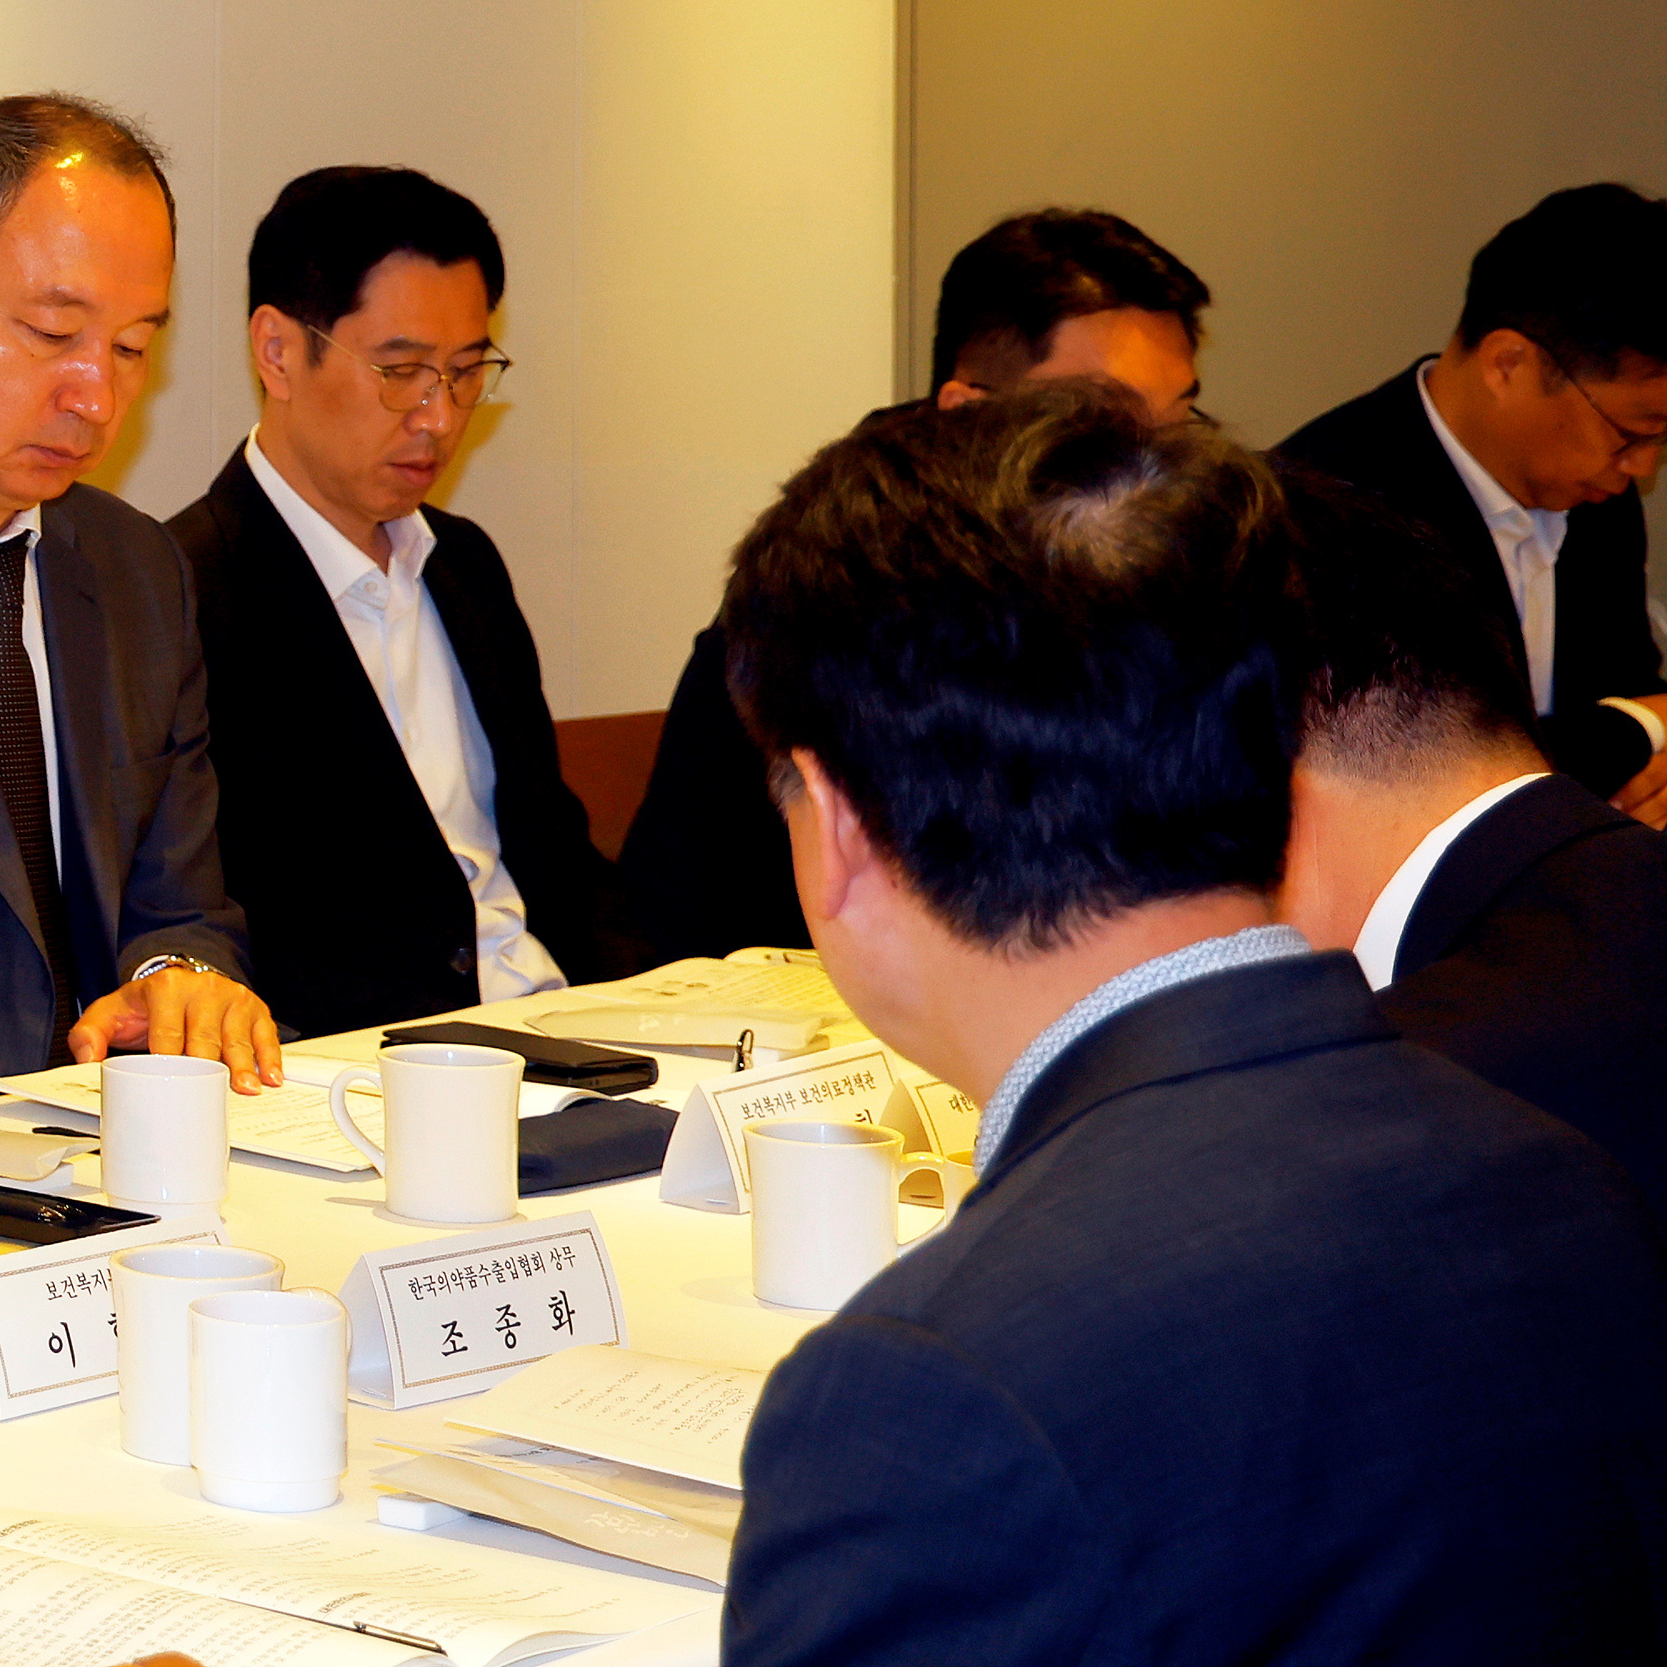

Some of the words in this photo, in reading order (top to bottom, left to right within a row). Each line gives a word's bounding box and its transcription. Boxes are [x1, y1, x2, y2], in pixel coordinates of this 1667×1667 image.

[740, 1090, 796, 1120] 보건복지부
[407, 1251, 546, 1301] 한국의약품수출입협회
[549, 1246, 576, 1272] 상무
[440, 1320, 469, 1357] 조
[494, 1303, 522, 1350] 종
[548, 1289, 576, 1336] 화
